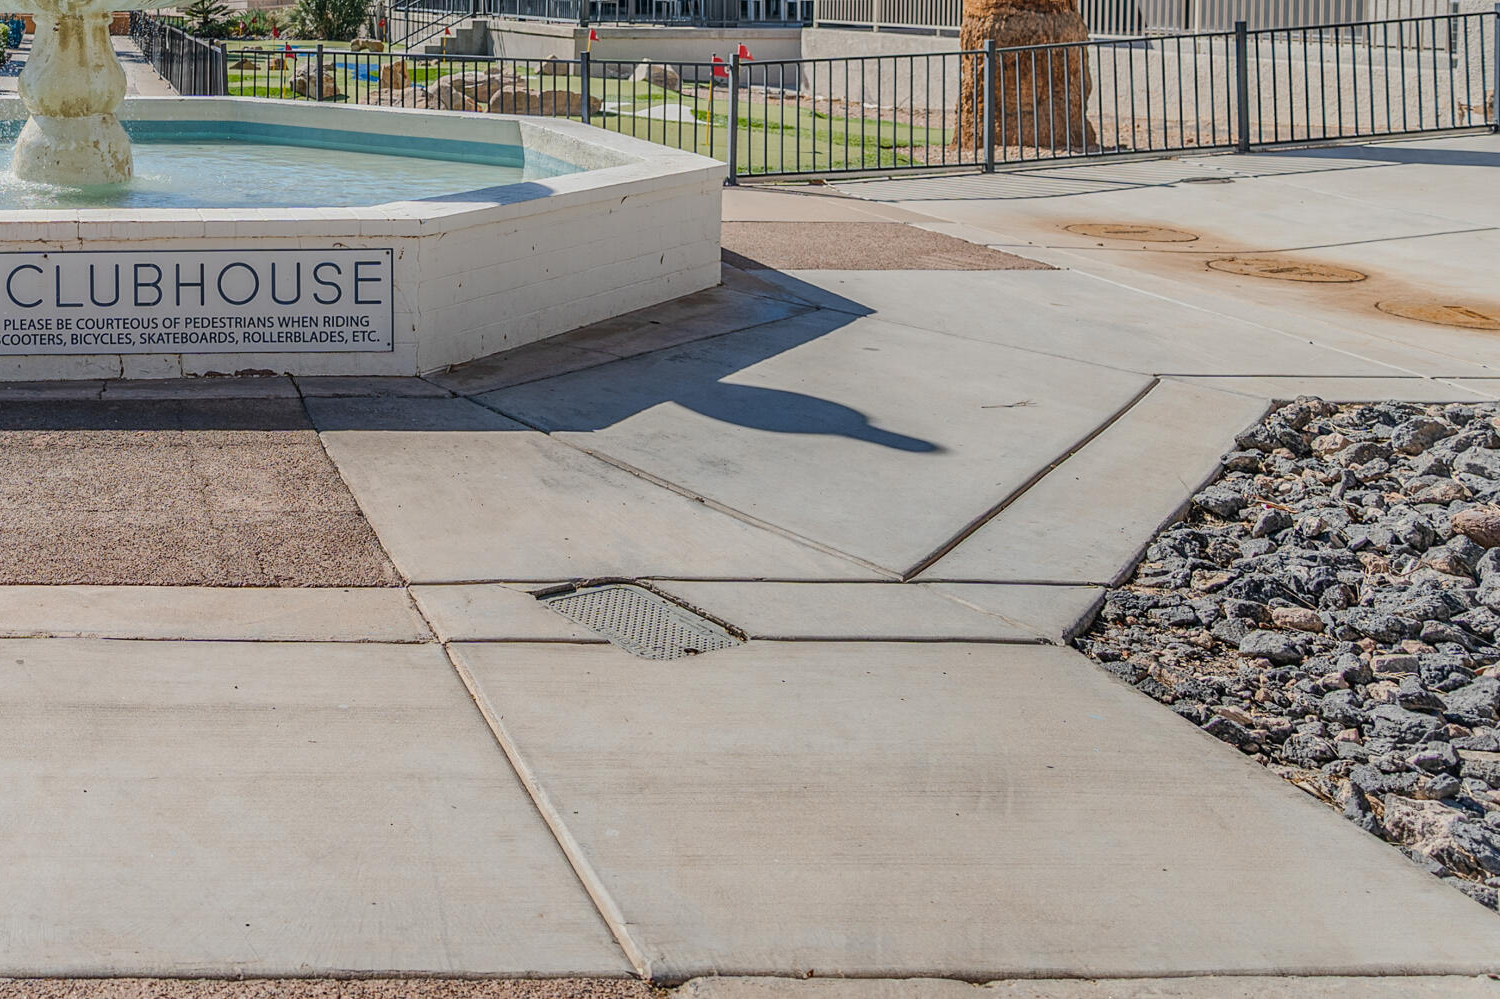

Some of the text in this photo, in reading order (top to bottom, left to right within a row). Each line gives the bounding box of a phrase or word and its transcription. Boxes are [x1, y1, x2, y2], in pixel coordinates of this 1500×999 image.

[6, 261, 382, 308] CLUBHOUSE
[3, 315, 370, 331] PLEASE BE COURTEOUS OF PEDESTRIANS WHEN RIDING
[71, 332, 136, 347] BICYCLES,
[139, 331, 239, 345] SKATEBOARDS,
[243, 330, 348, 345] ROLLERBLADES,
[352, 330, 381, 343] ETC.
